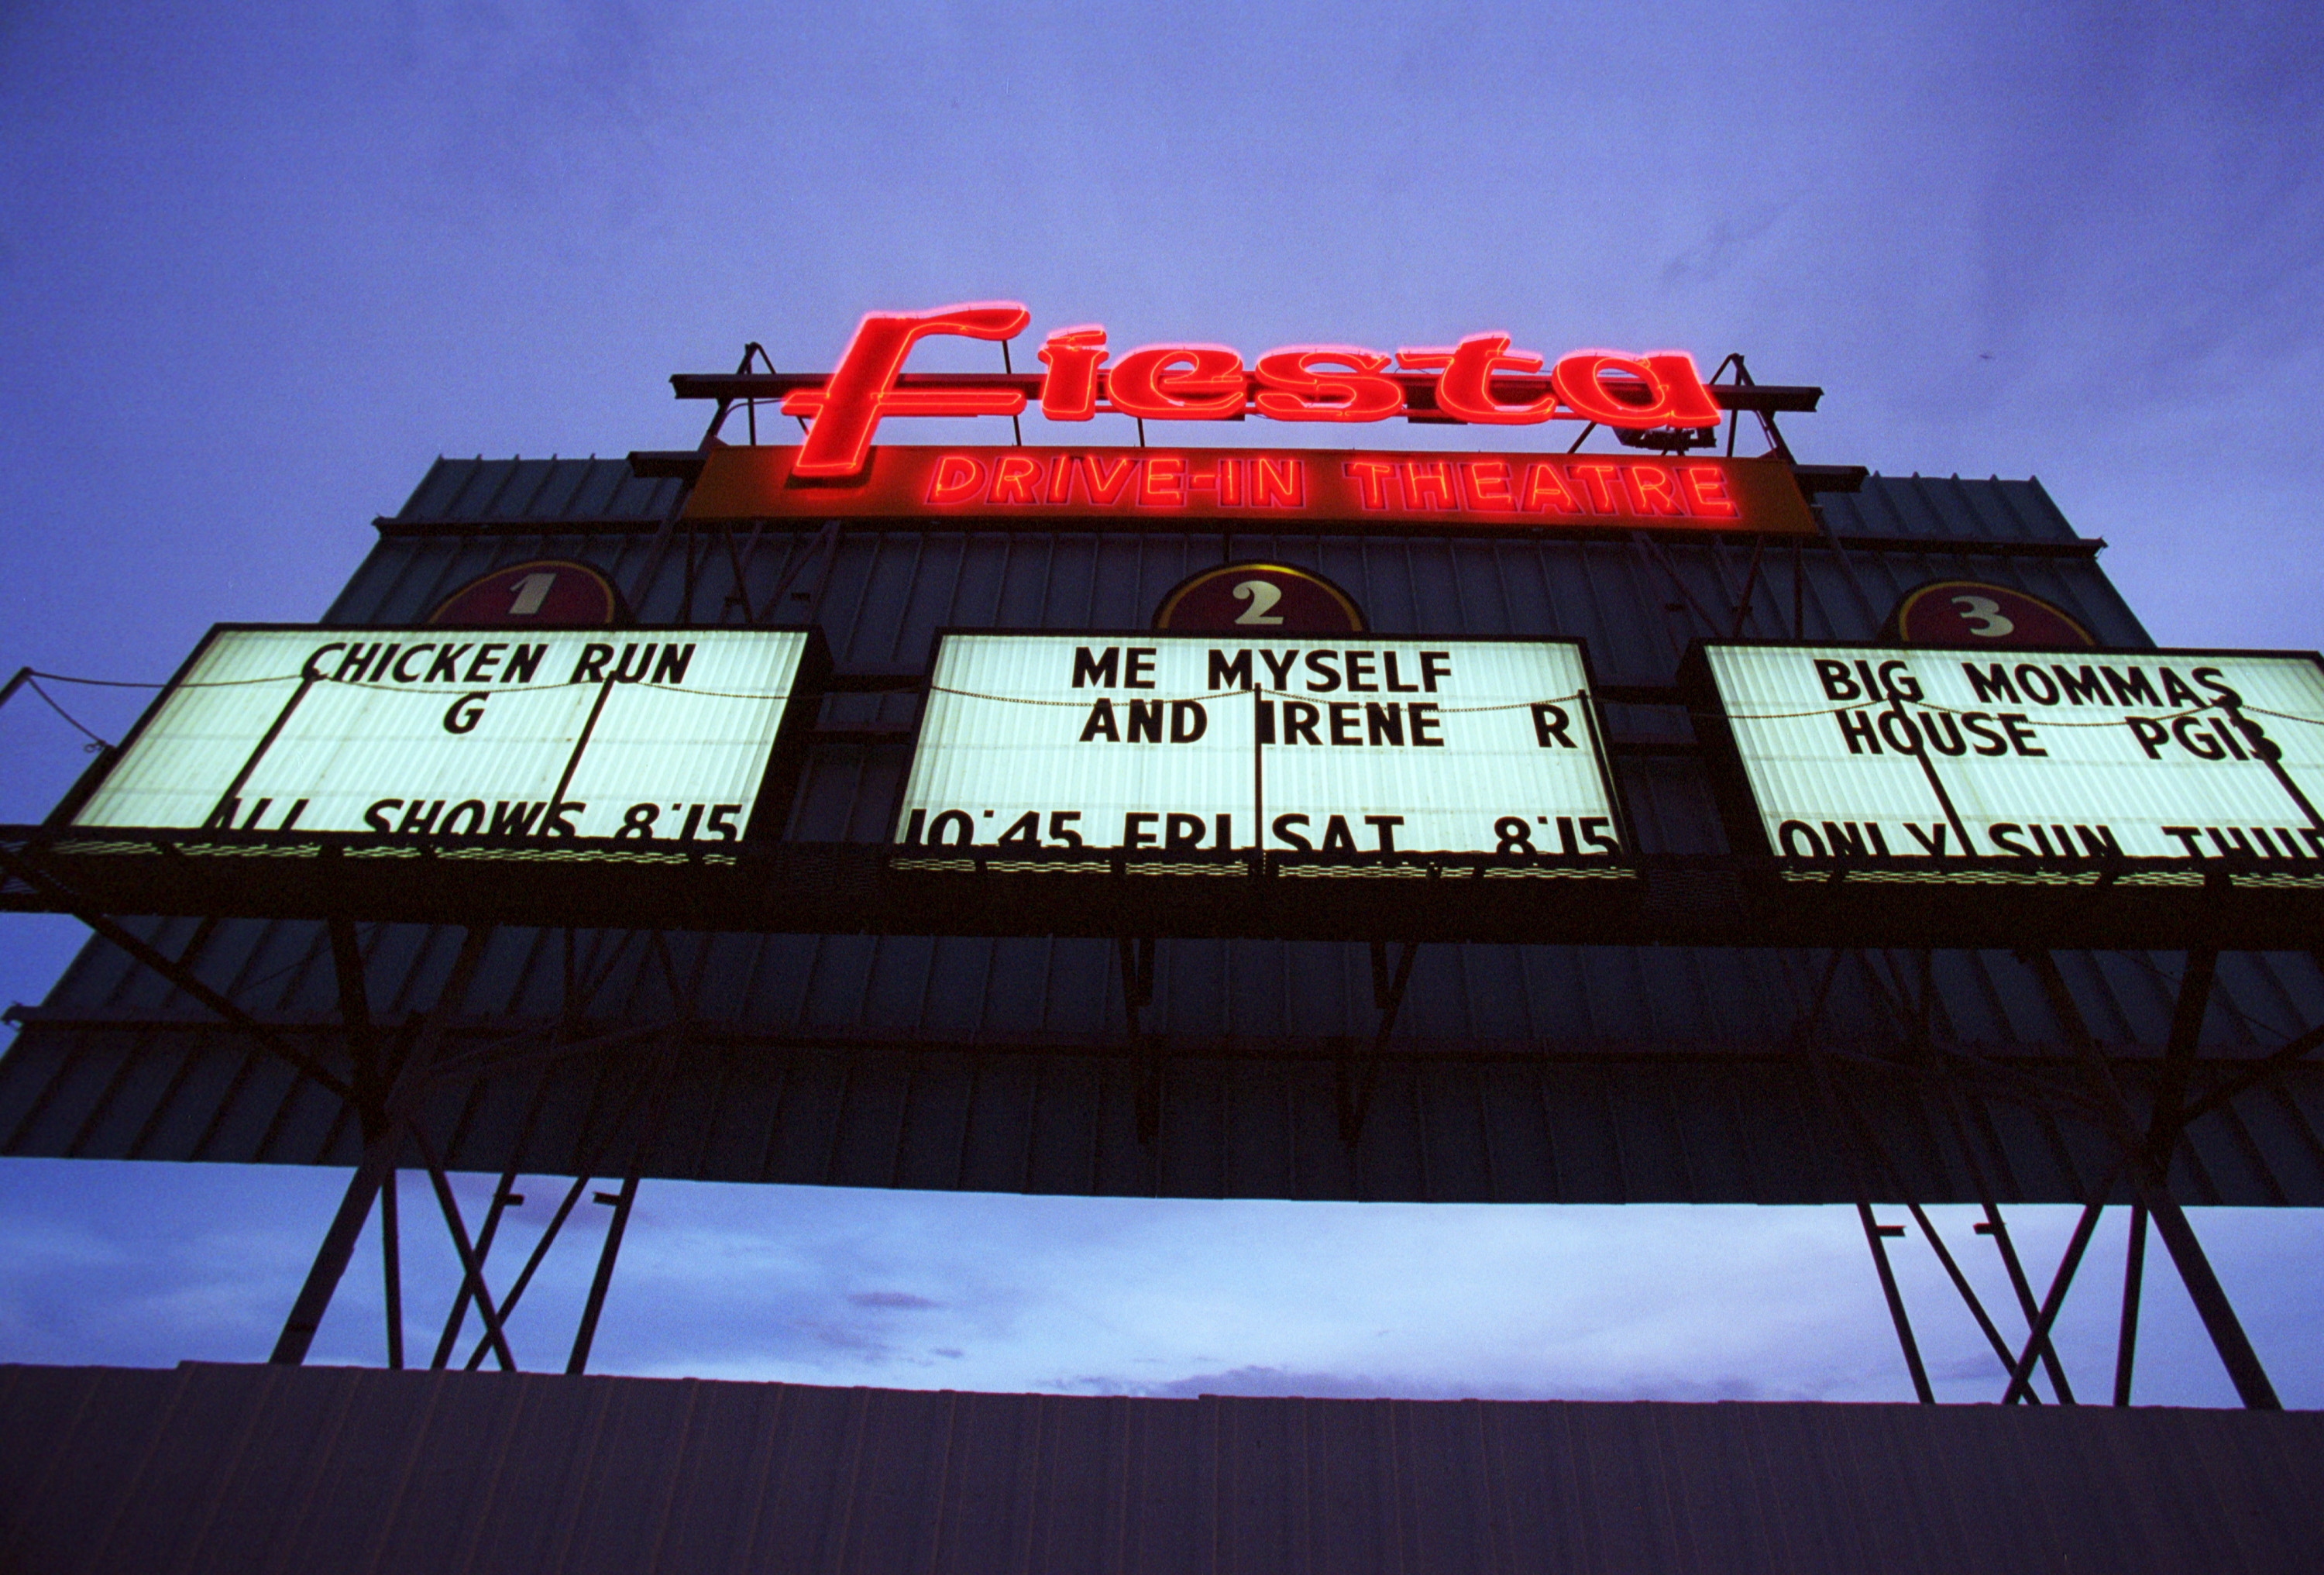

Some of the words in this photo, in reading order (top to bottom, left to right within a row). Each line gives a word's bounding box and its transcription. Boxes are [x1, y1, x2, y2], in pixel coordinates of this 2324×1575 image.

[924, 456, 1306, 508] DRIVE-IN
[1342, 462, 1741, 518] THEATRE
[509, 573, 557, 614] 1
[1232, 580, 1284, 624] 2
[1951, 596, 2014, 638] 3
[301, 642, 549, 683] CHICKEN
[569, 643, 696, 683] RUN
[1071, 647, 1157, 688] ME
[1208, 648, 1452, 693] MYSELF
[1813, 659, 1924, 702] BIG
[1961, 662, 2243, 709] MOMMAS
[442, 692, 491, 734] G
[1079, 698, 1207, 743] AND
[1260, 700, 1445, 746] IRENE
[1531, 703, 1578, 748] R
[1834, 710, 2049, 757] HOUSE
[363, 798, 586, 837] SHOWS
[1124, 812, 1232, 849] FRI
[1272, 813, 1404, 851] SAT
